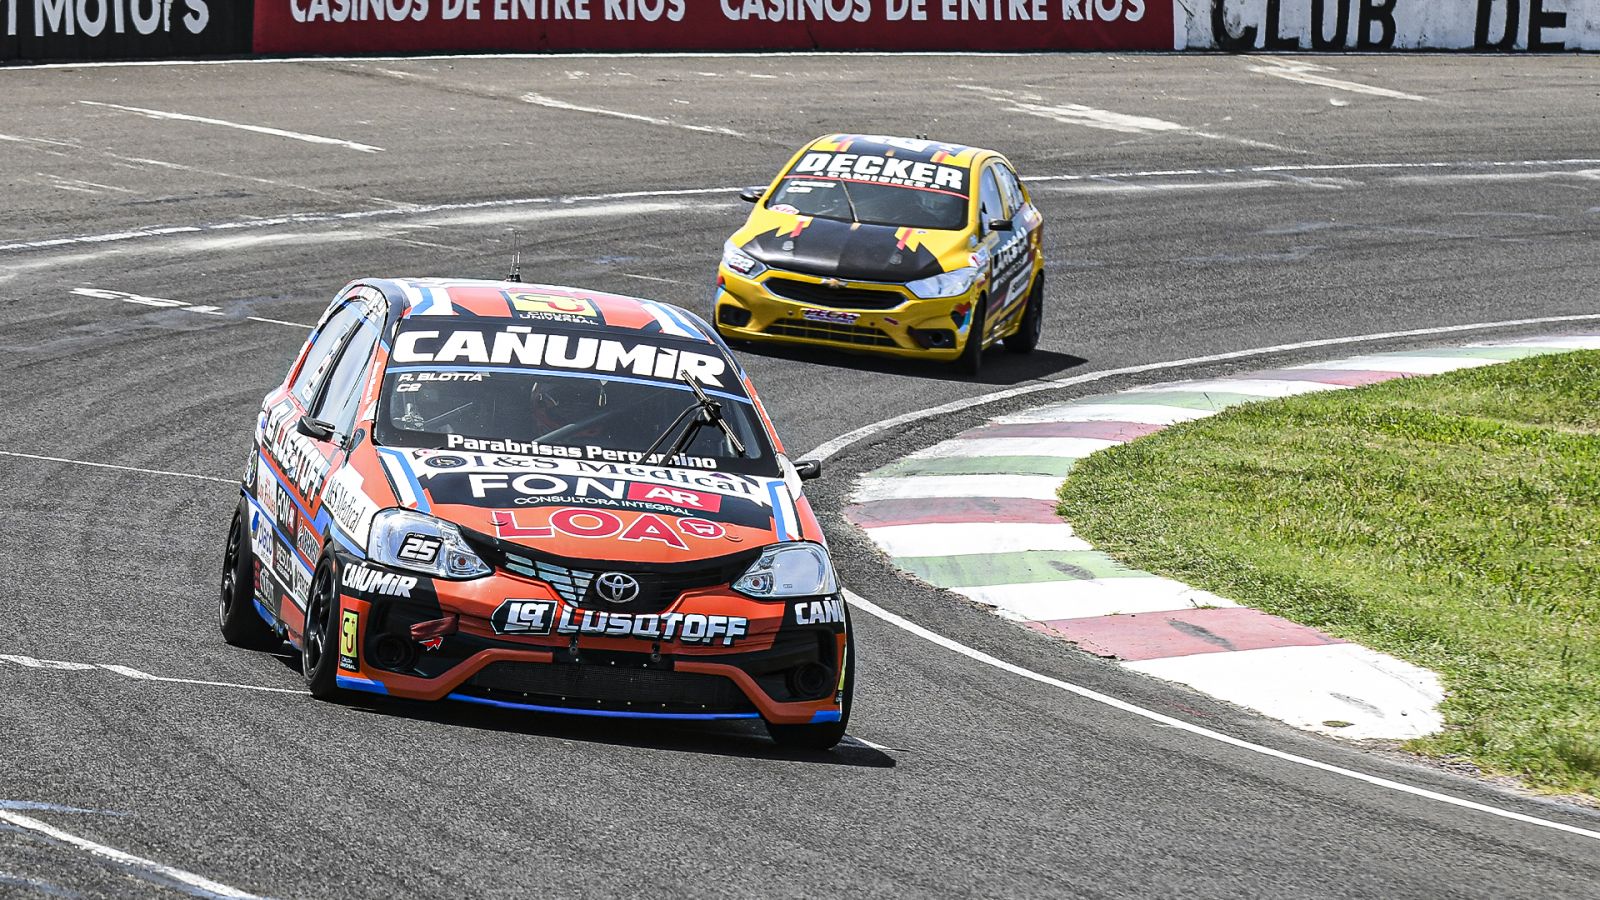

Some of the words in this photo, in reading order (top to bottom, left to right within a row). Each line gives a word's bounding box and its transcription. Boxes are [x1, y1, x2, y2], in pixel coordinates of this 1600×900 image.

[290, 0, 429, 22] CASINOS
[443, 0, 481, 20] DE
[494, 0, 591, 20] ENTRE
[720, 0, 872, 22] CASINOS
[886, 0, 927, 20] DE
[942, 0, 1048, 20] ENTRE
[1211, 0, 1396, 51] CLUB
[1474, 0, 1567, 51] DE
[795, 151, 963, 190] DECKER
[416, 372, 483, 382] BLOTTA
[447, 433, 583, 458] Parabrisas
[468, 473, 626, 500] FON
[644, 487, 704, 508] AR
[577, 461, 756, 496] Medical
[514, 495, 618, 506] CONSULTORA
[621, 500, 694, 516] INTEGRAL
[400, 537, 441, 562] 25
